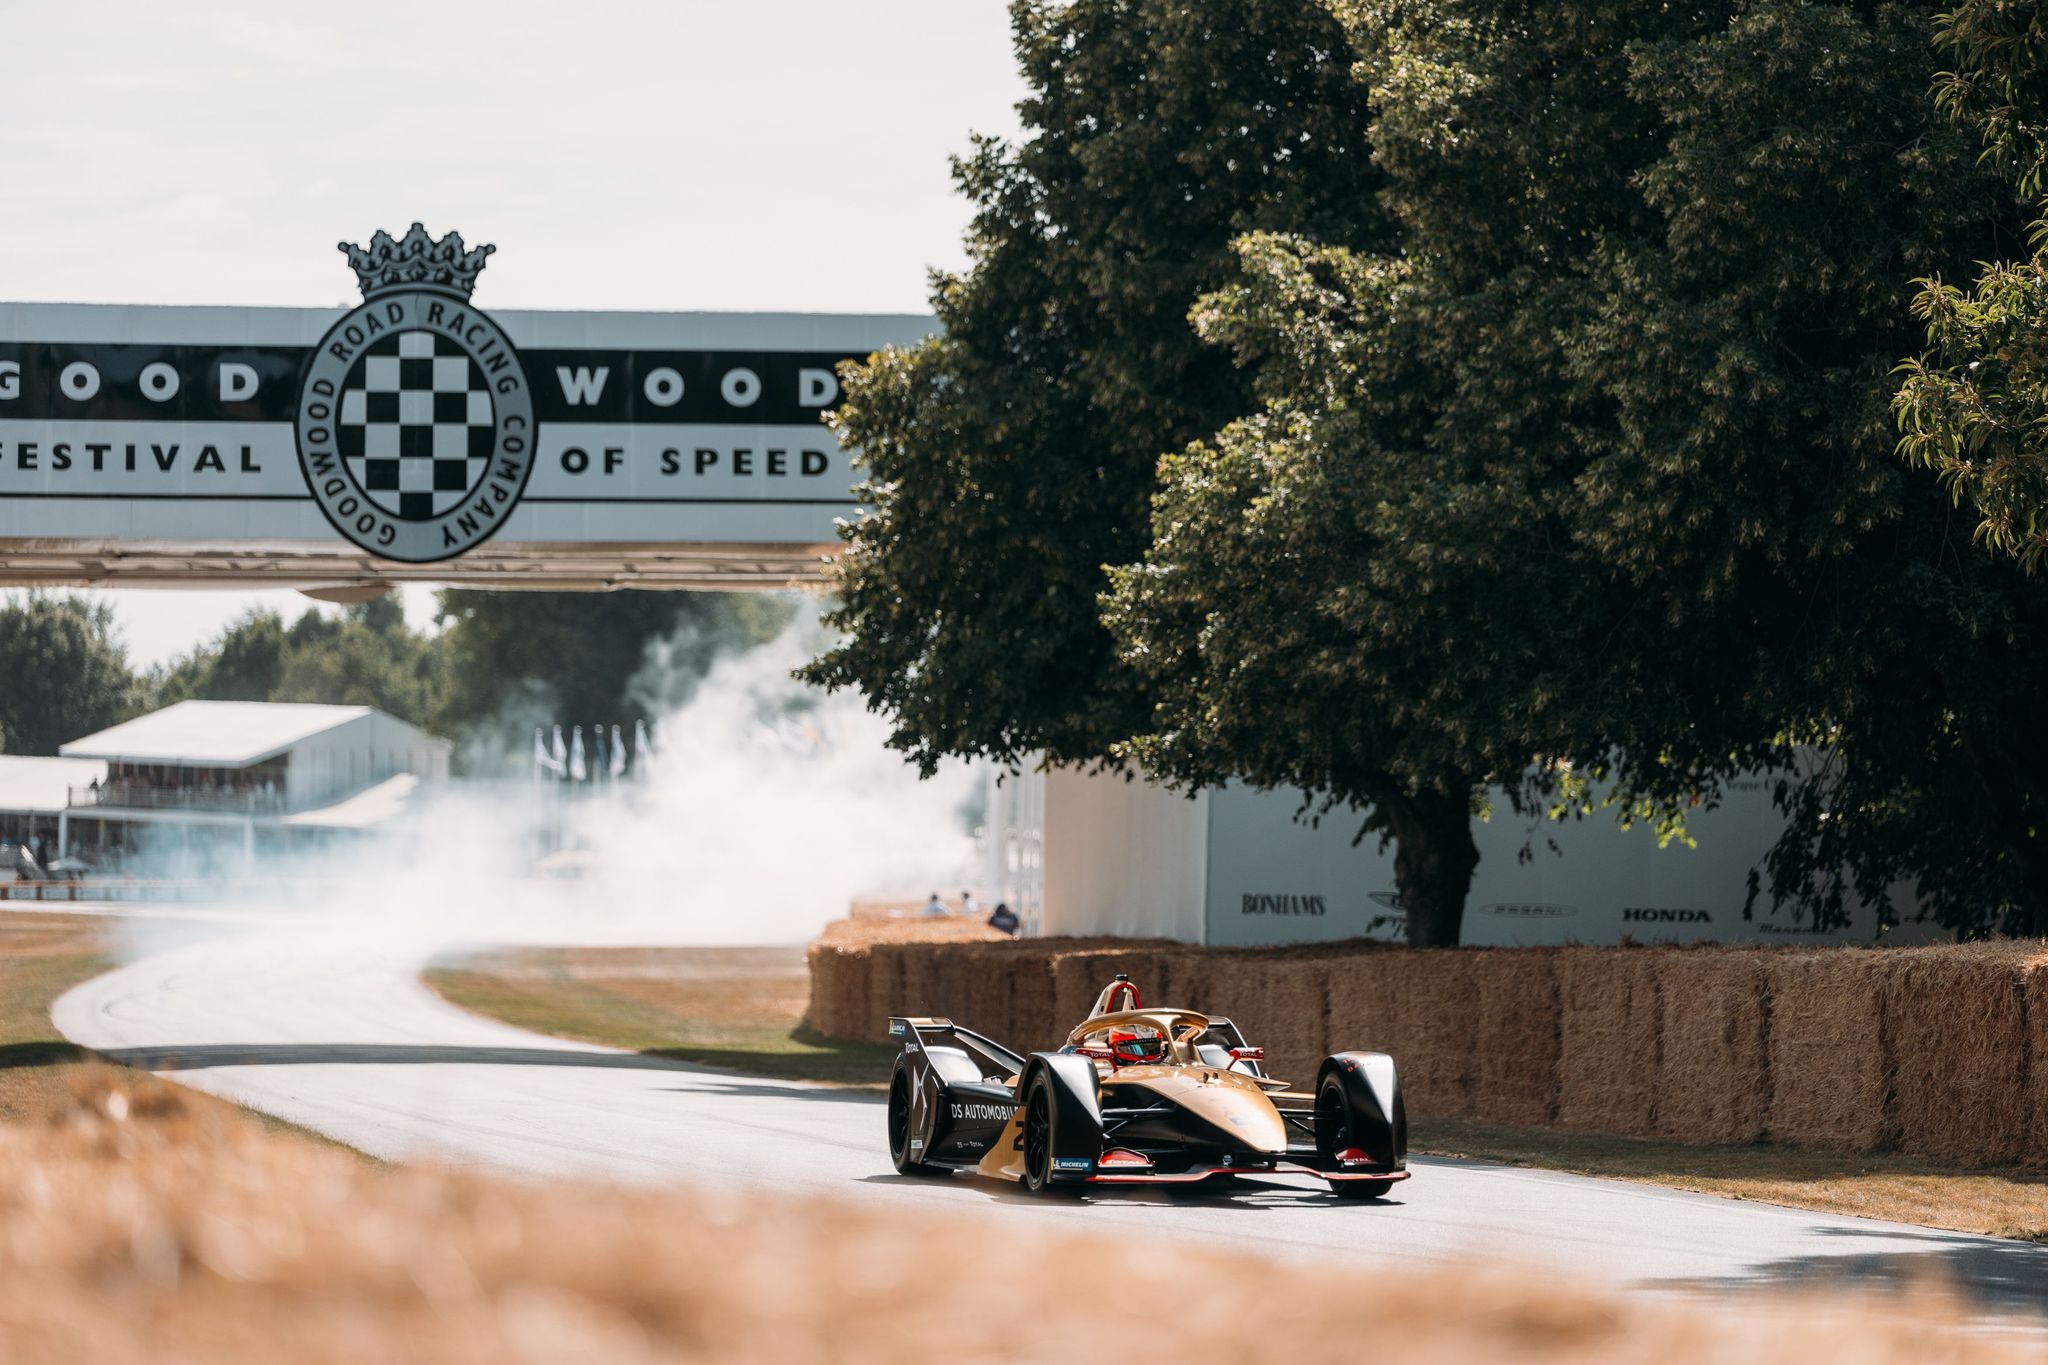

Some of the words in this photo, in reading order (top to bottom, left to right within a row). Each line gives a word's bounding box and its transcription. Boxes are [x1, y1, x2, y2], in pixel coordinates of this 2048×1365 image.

[328, 302, 404, 363] ROAD
[427, 302, 519, 394] RACING
[0, 360, 260, 402] GOOD
[555, 366, 839, 407] WOOD
[0, 442, 262, 473] ESTIVAL
[560, 446, 625, 475] OF
[660, 448, 829, 477] SPEED
[307, 378, 397, 546] GOODWOOD
[441, 414, 526, 549] COMPANY
[1241, 893, 1326, 917] BONHAMS
[1623, 907, 1712, 923] HONDA
[951, 1103, 963, 1119] DS
[1060, 1161, 1089, 1169] MICHELIN
